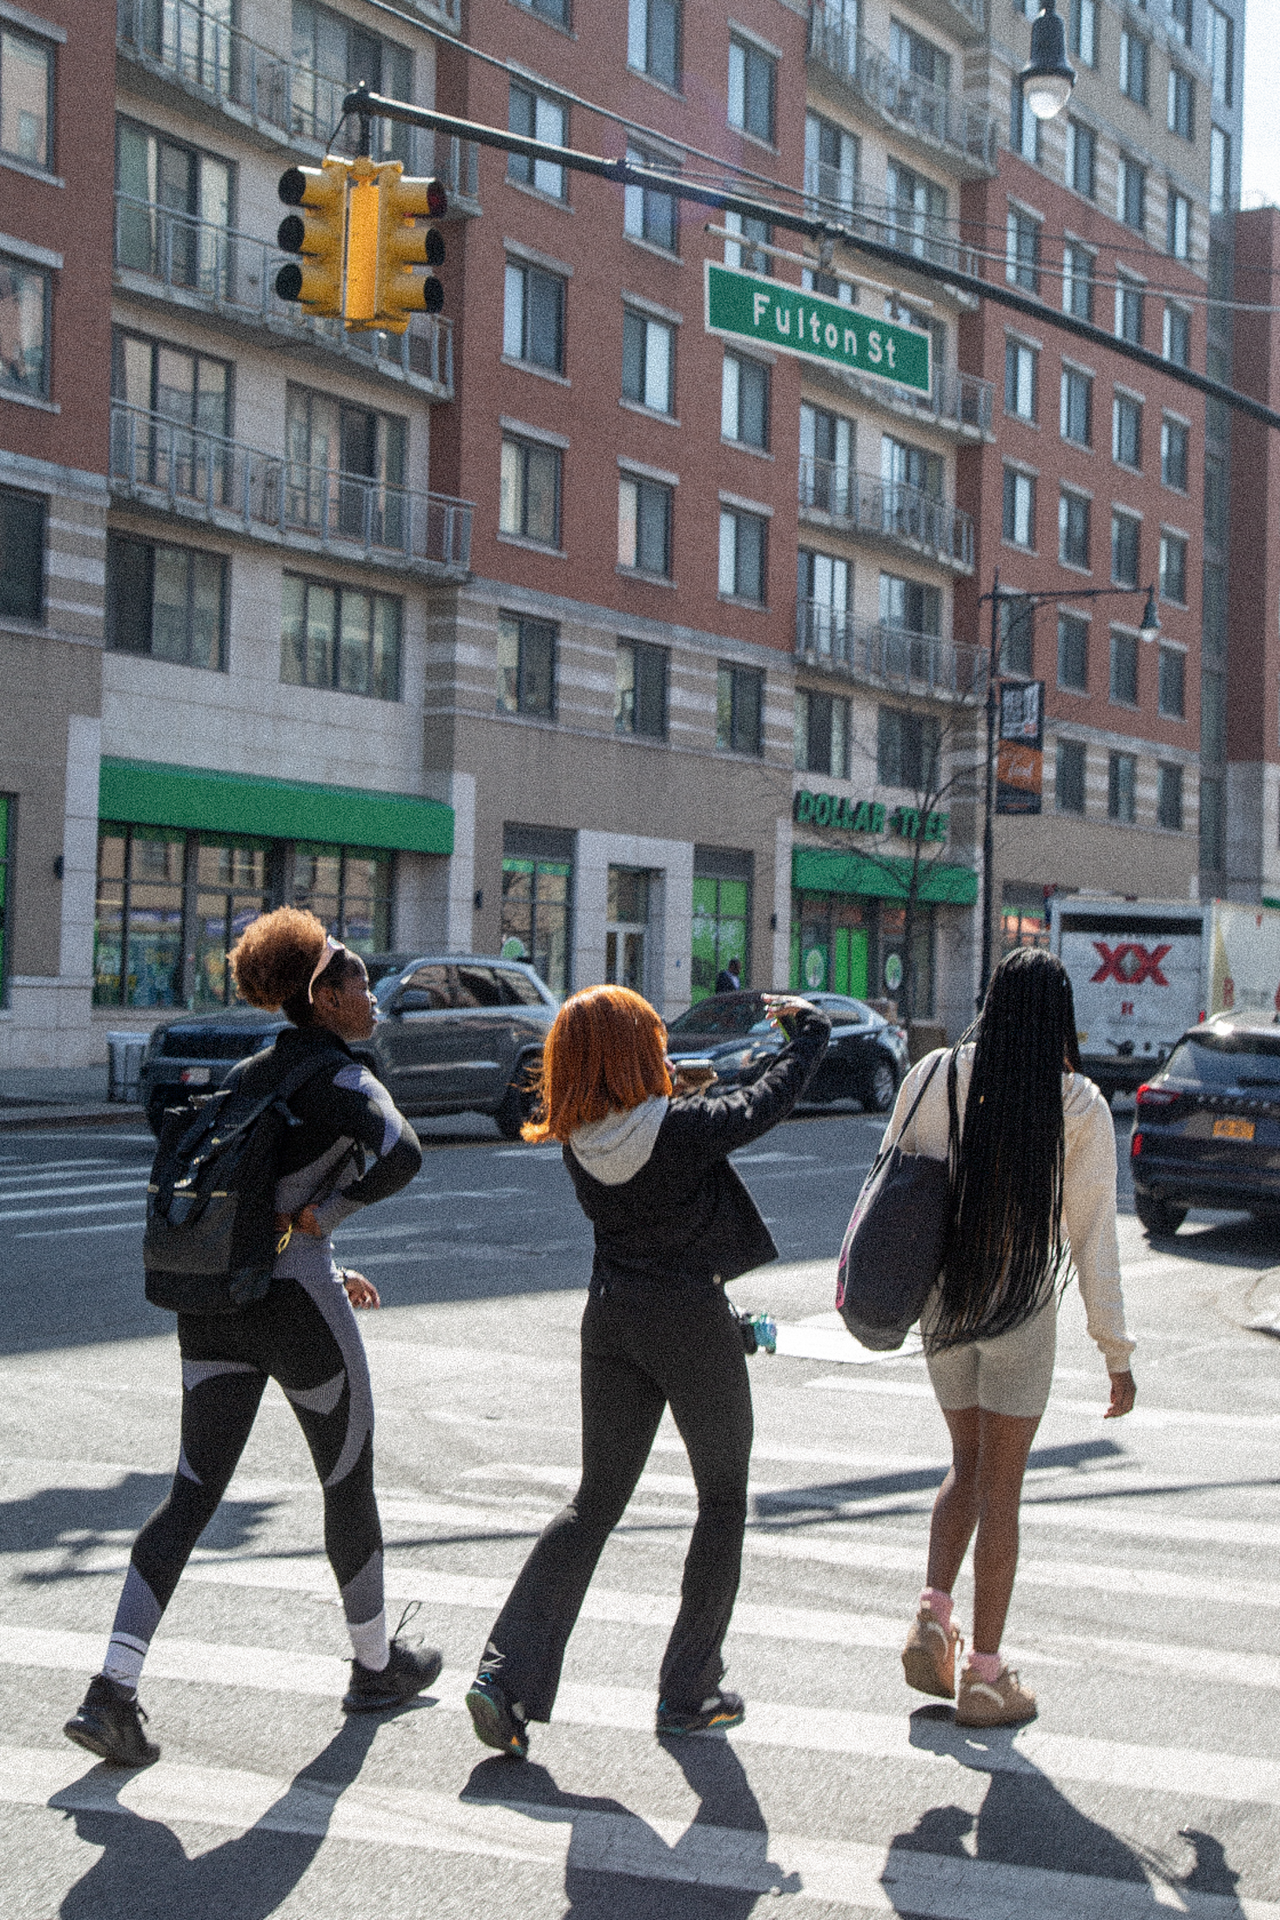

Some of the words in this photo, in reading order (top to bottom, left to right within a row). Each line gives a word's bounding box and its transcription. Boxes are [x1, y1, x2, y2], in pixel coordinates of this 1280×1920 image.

[753, 292, 857, 356] Fulton
[868, 330, 896, 368] St
[796, 789, 886, 834] DOLLAR
